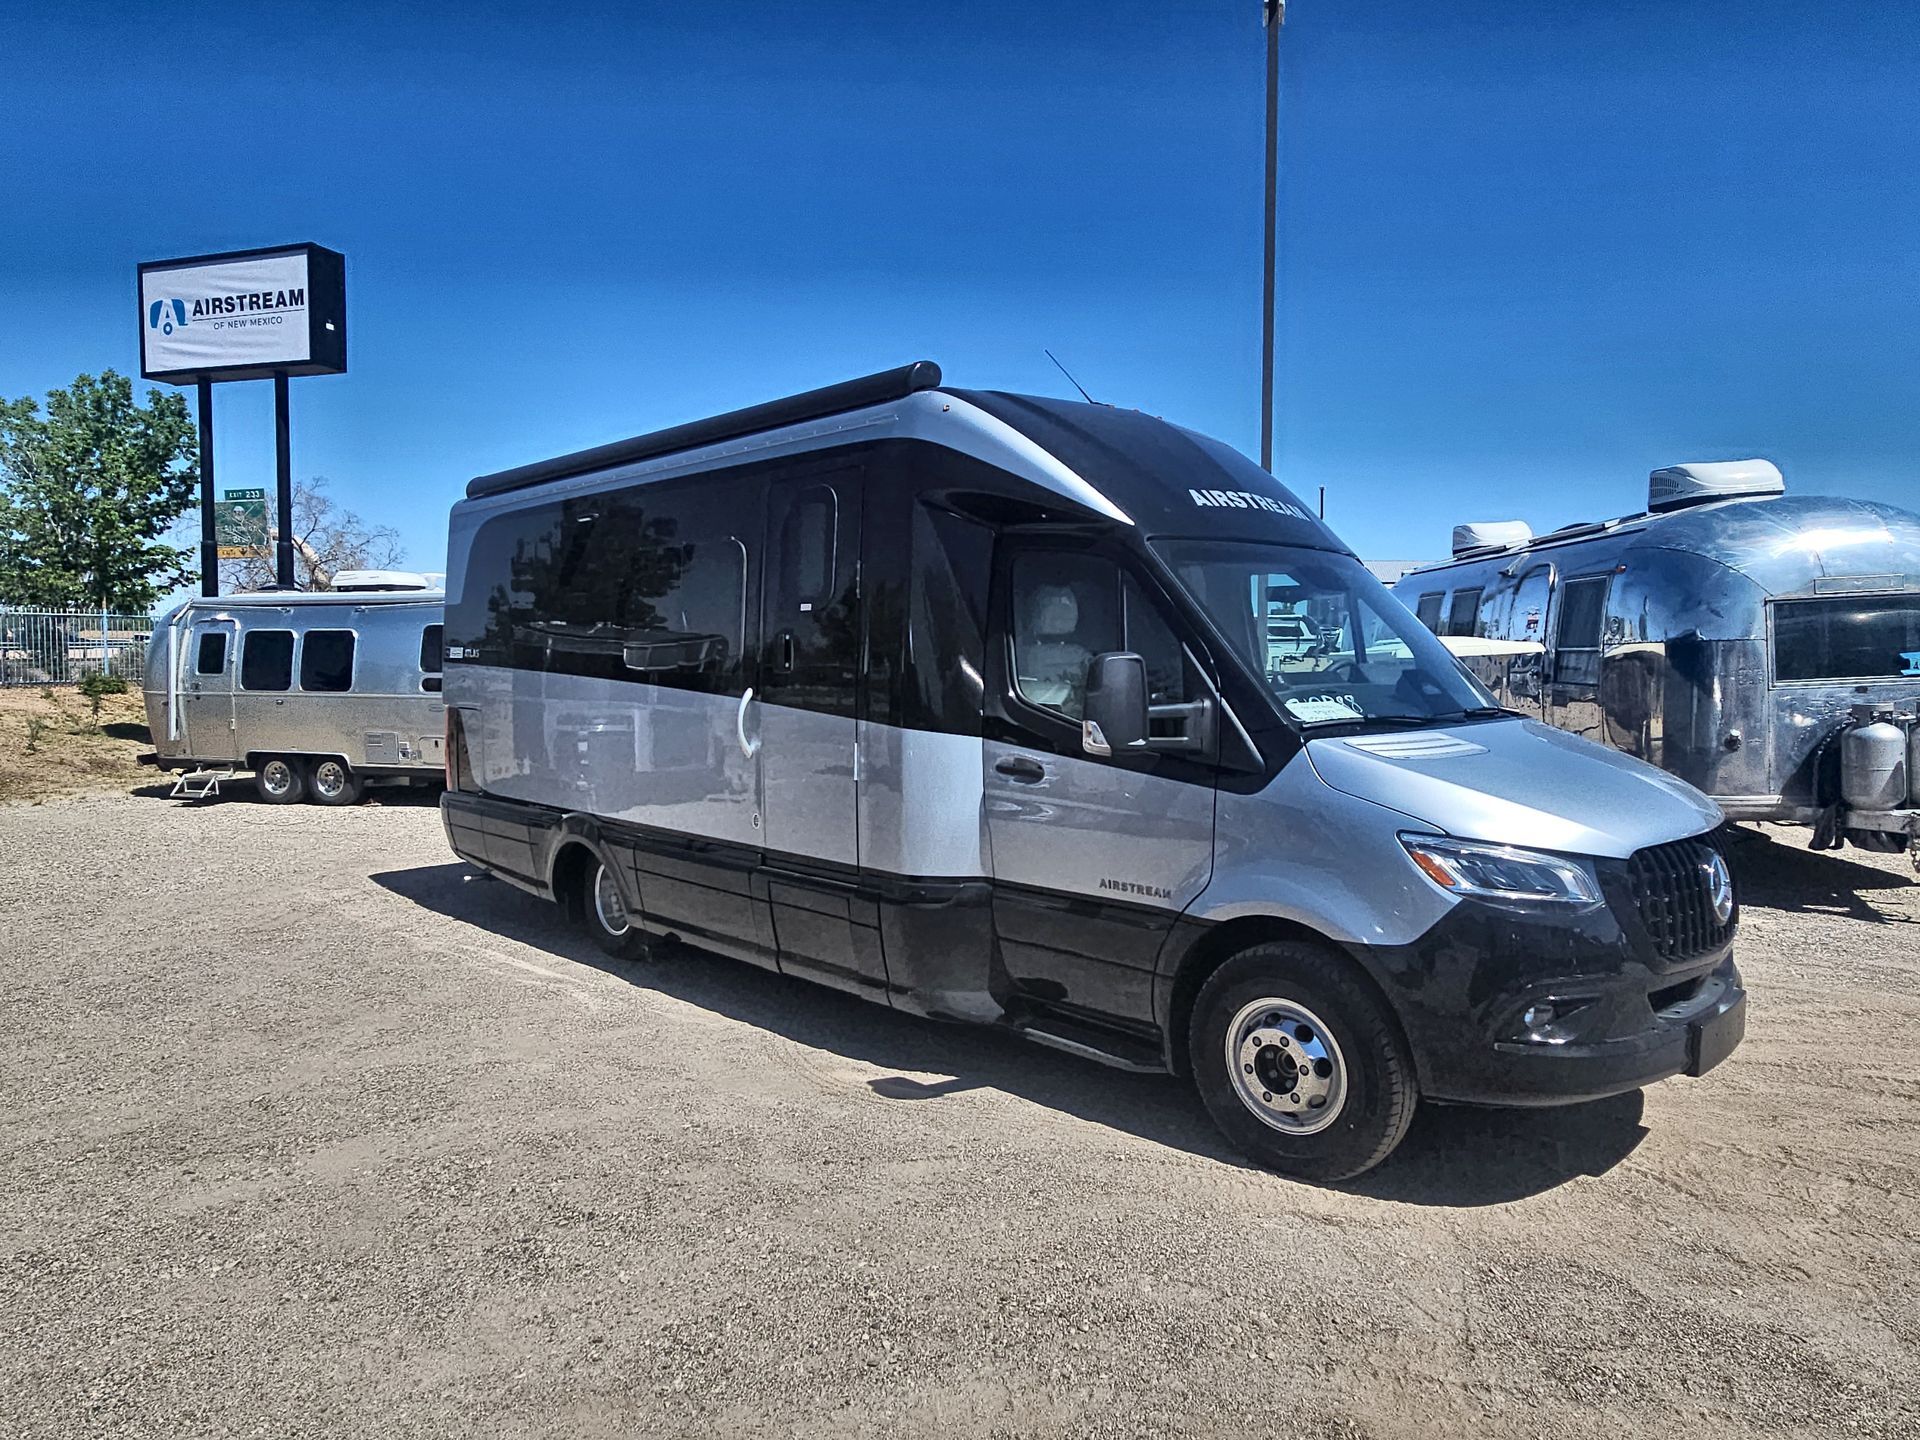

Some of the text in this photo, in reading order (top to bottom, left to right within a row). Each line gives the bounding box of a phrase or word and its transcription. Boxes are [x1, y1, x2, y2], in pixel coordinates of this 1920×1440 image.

[193, 288, 305, 317] AIRSTREAM
[214, 316, 283, 330] OF NEW MEXICO
[1188, 489, 1311, 521] AIRSTREAM
[1099, 878, 1172, 899] AIRSTREAM
